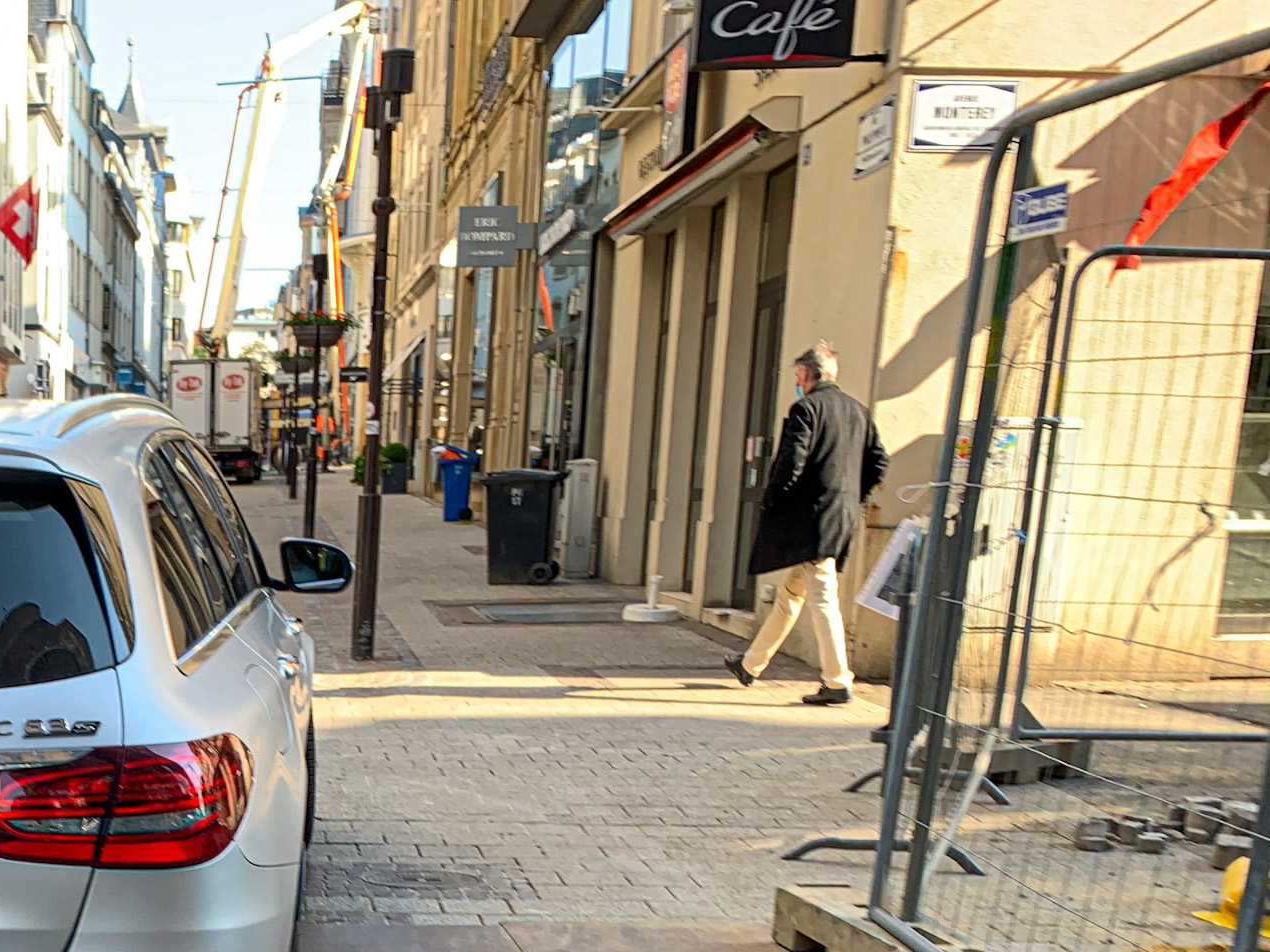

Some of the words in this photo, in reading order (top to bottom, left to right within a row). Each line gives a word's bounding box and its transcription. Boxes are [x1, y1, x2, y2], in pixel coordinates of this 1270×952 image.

[711, 0, 841, 61] Café
[934, 106, 995, 118] MONTEREY
[474, 217, 500, 227] ERIC
